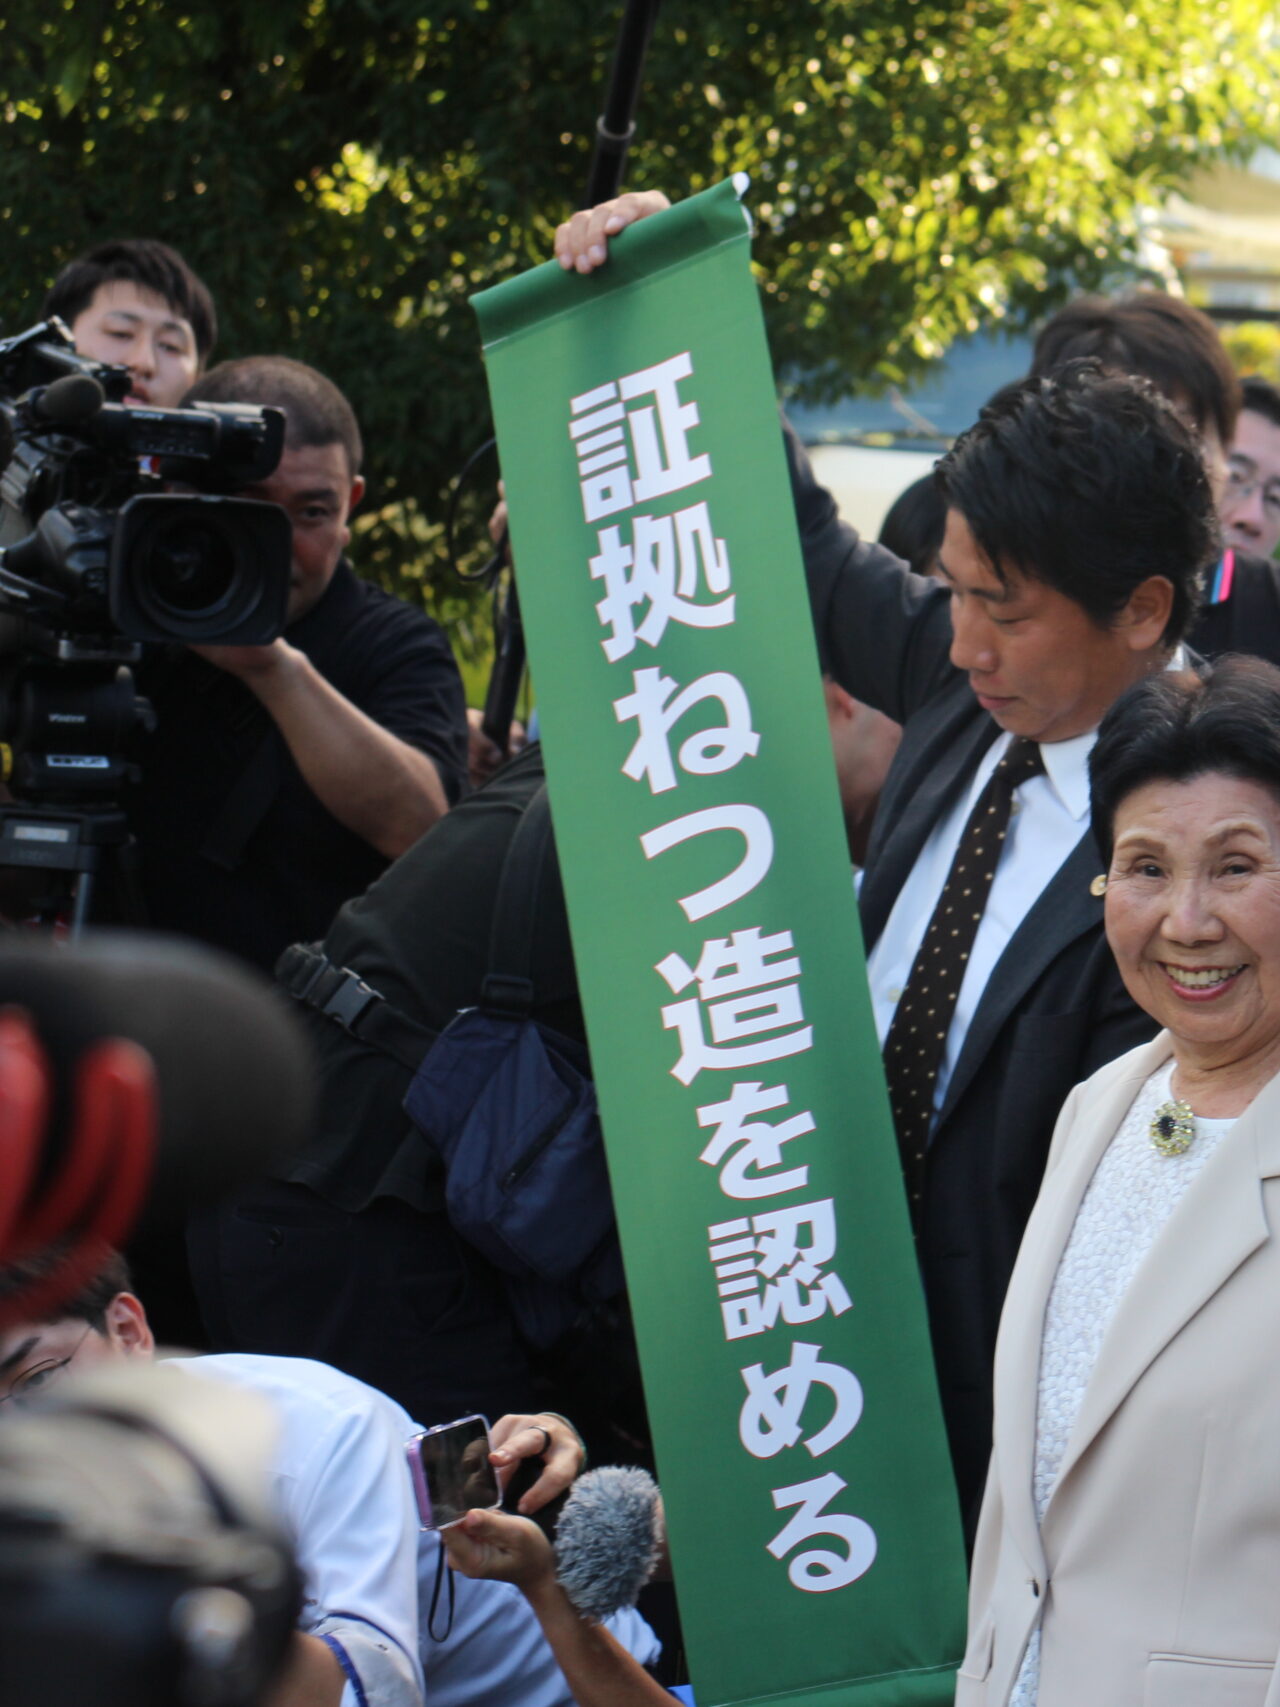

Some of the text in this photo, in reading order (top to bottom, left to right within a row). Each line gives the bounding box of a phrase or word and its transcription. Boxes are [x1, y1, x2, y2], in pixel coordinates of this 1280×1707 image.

[569, 351, 879, 1593] 証拠ねつ造を認める
